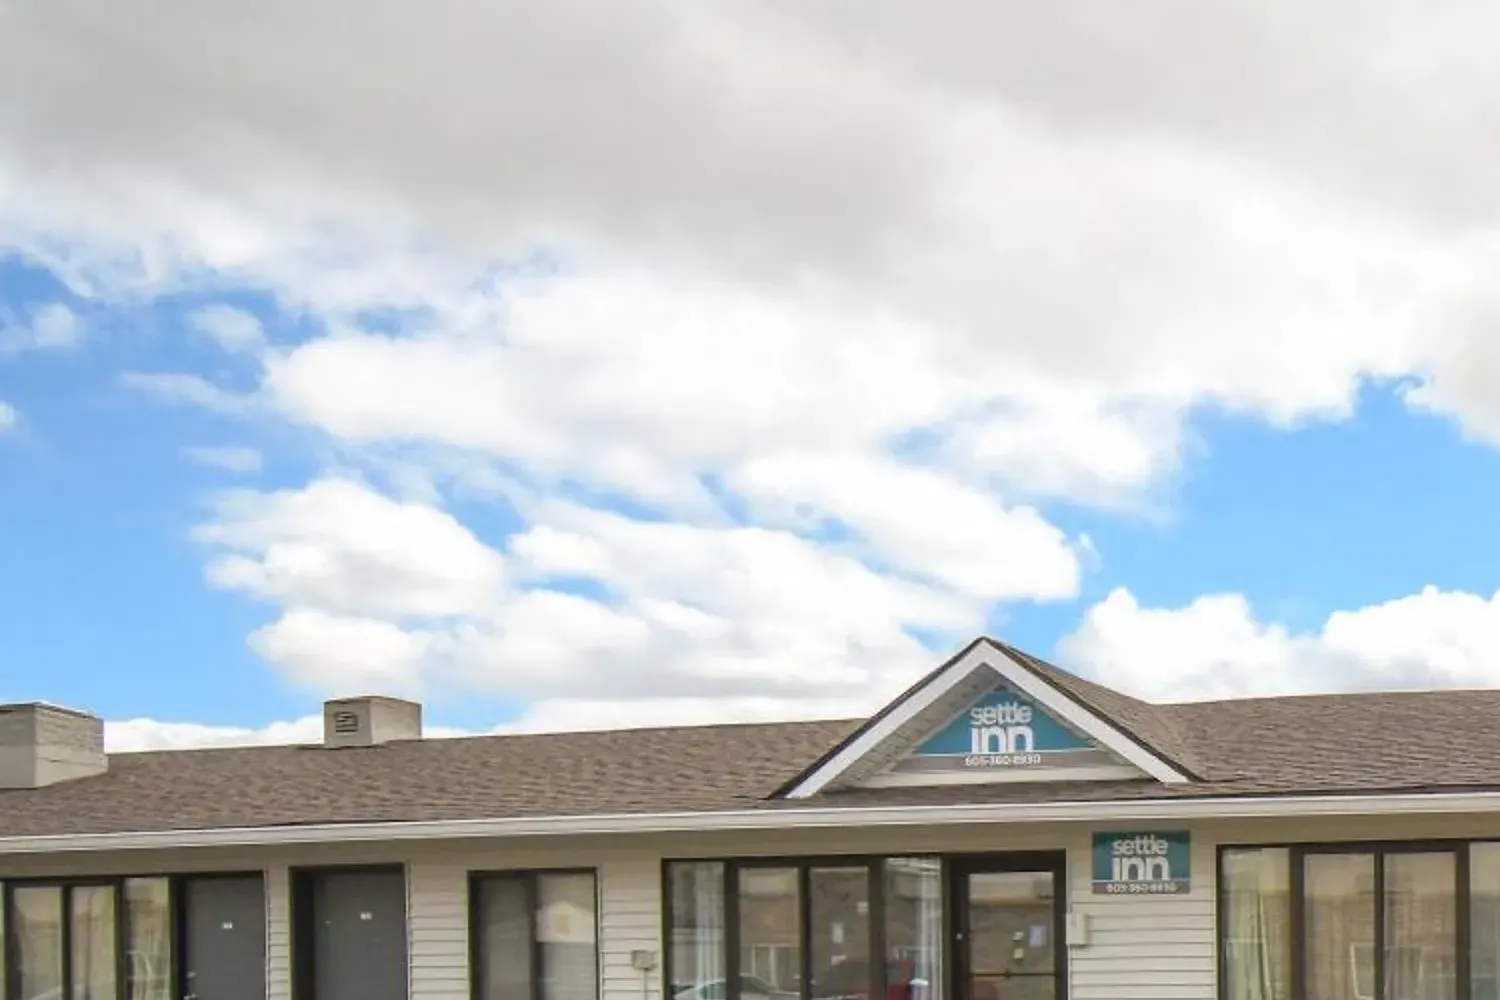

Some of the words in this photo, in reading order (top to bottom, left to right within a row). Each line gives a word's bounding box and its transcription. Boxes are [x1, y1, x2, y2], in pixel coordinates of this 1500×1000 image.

[970, 702, 1032, 725] settle
[971, 725, 1034, 755] inn
[1112, 834, 1169, 855] settle
[1112, 855, 1170, 881] inn
